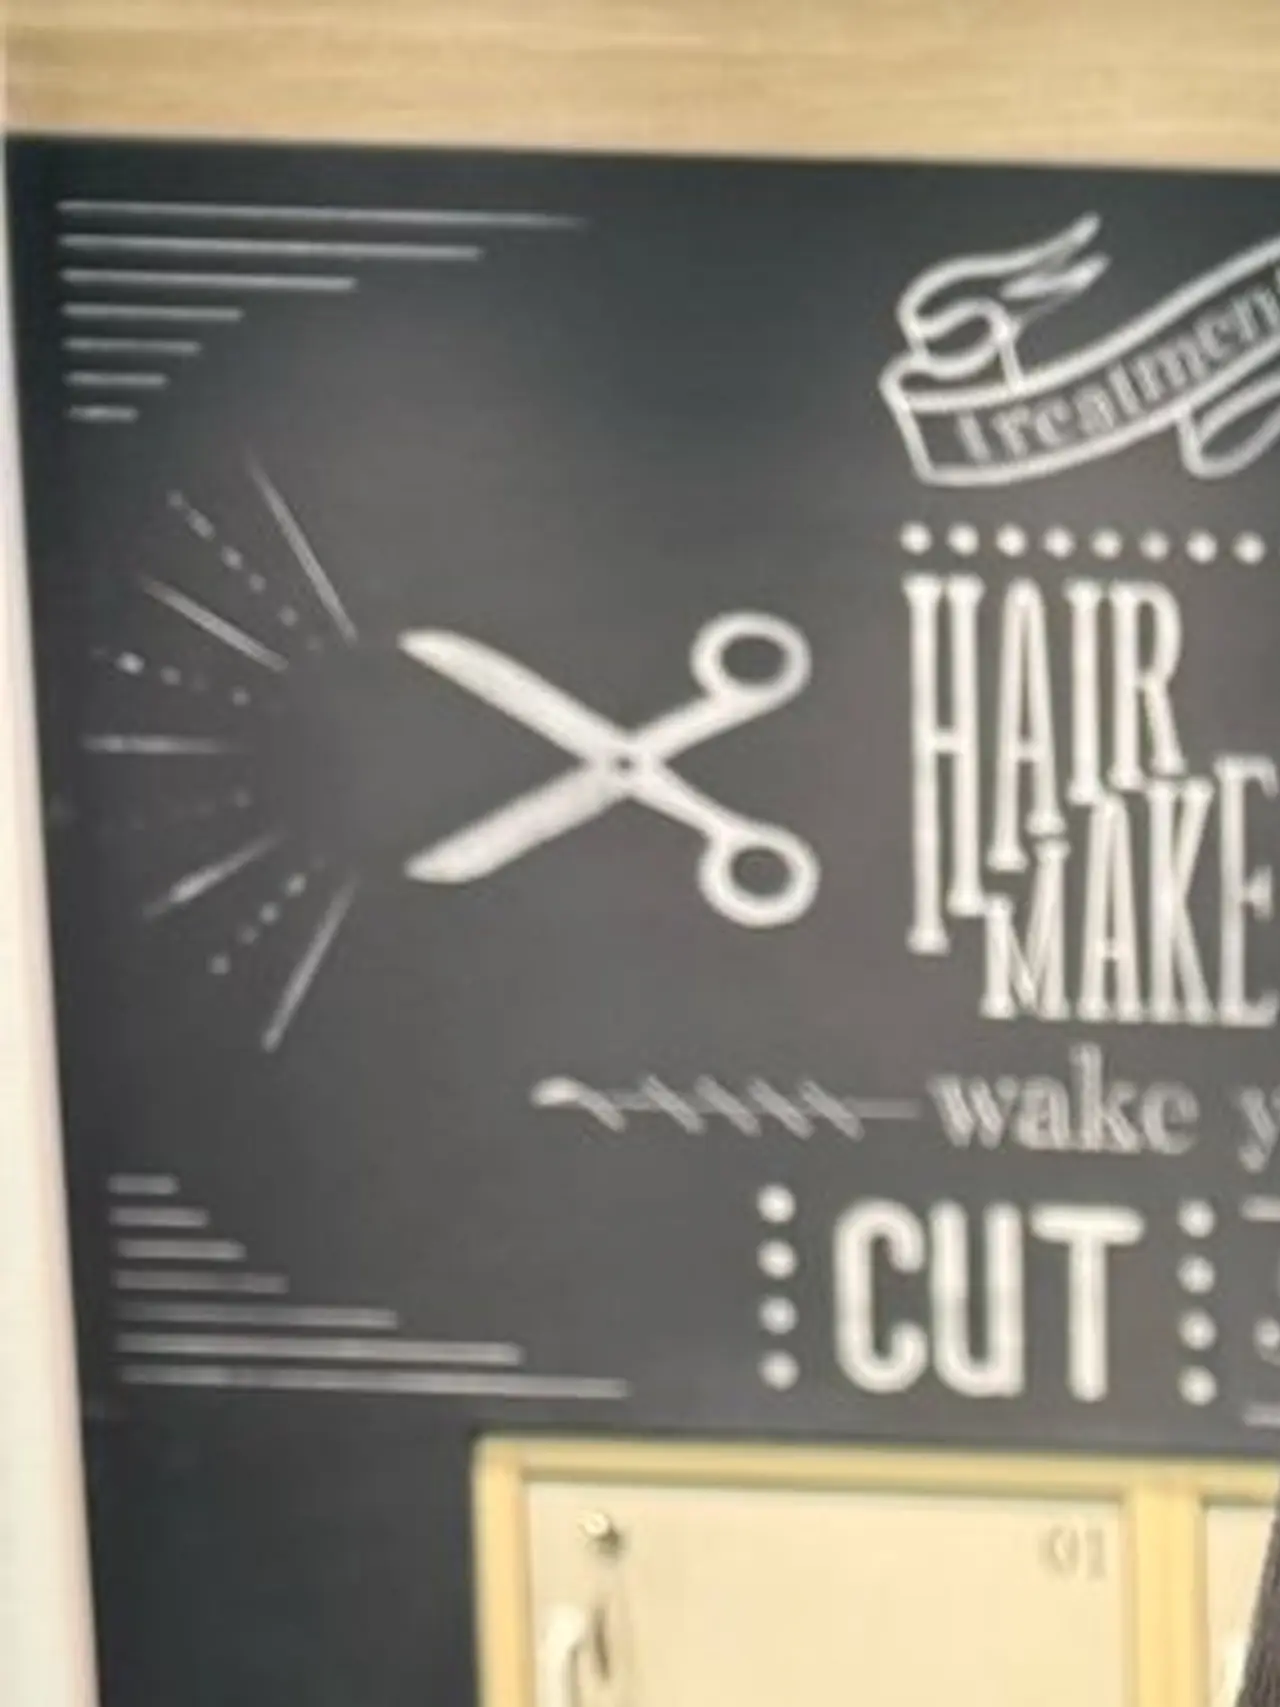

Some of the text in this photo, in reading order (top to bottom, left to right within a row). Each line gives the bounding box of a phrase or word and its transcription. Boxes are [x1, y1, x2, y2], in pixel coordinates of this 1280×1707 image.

[903, 573, 1186, 955] HAIR
[980, 754, 1280, 1028] MAKE
[926, 1041, 1200, 1156] wake
[832, 1198, 1145, 1402] CUT
